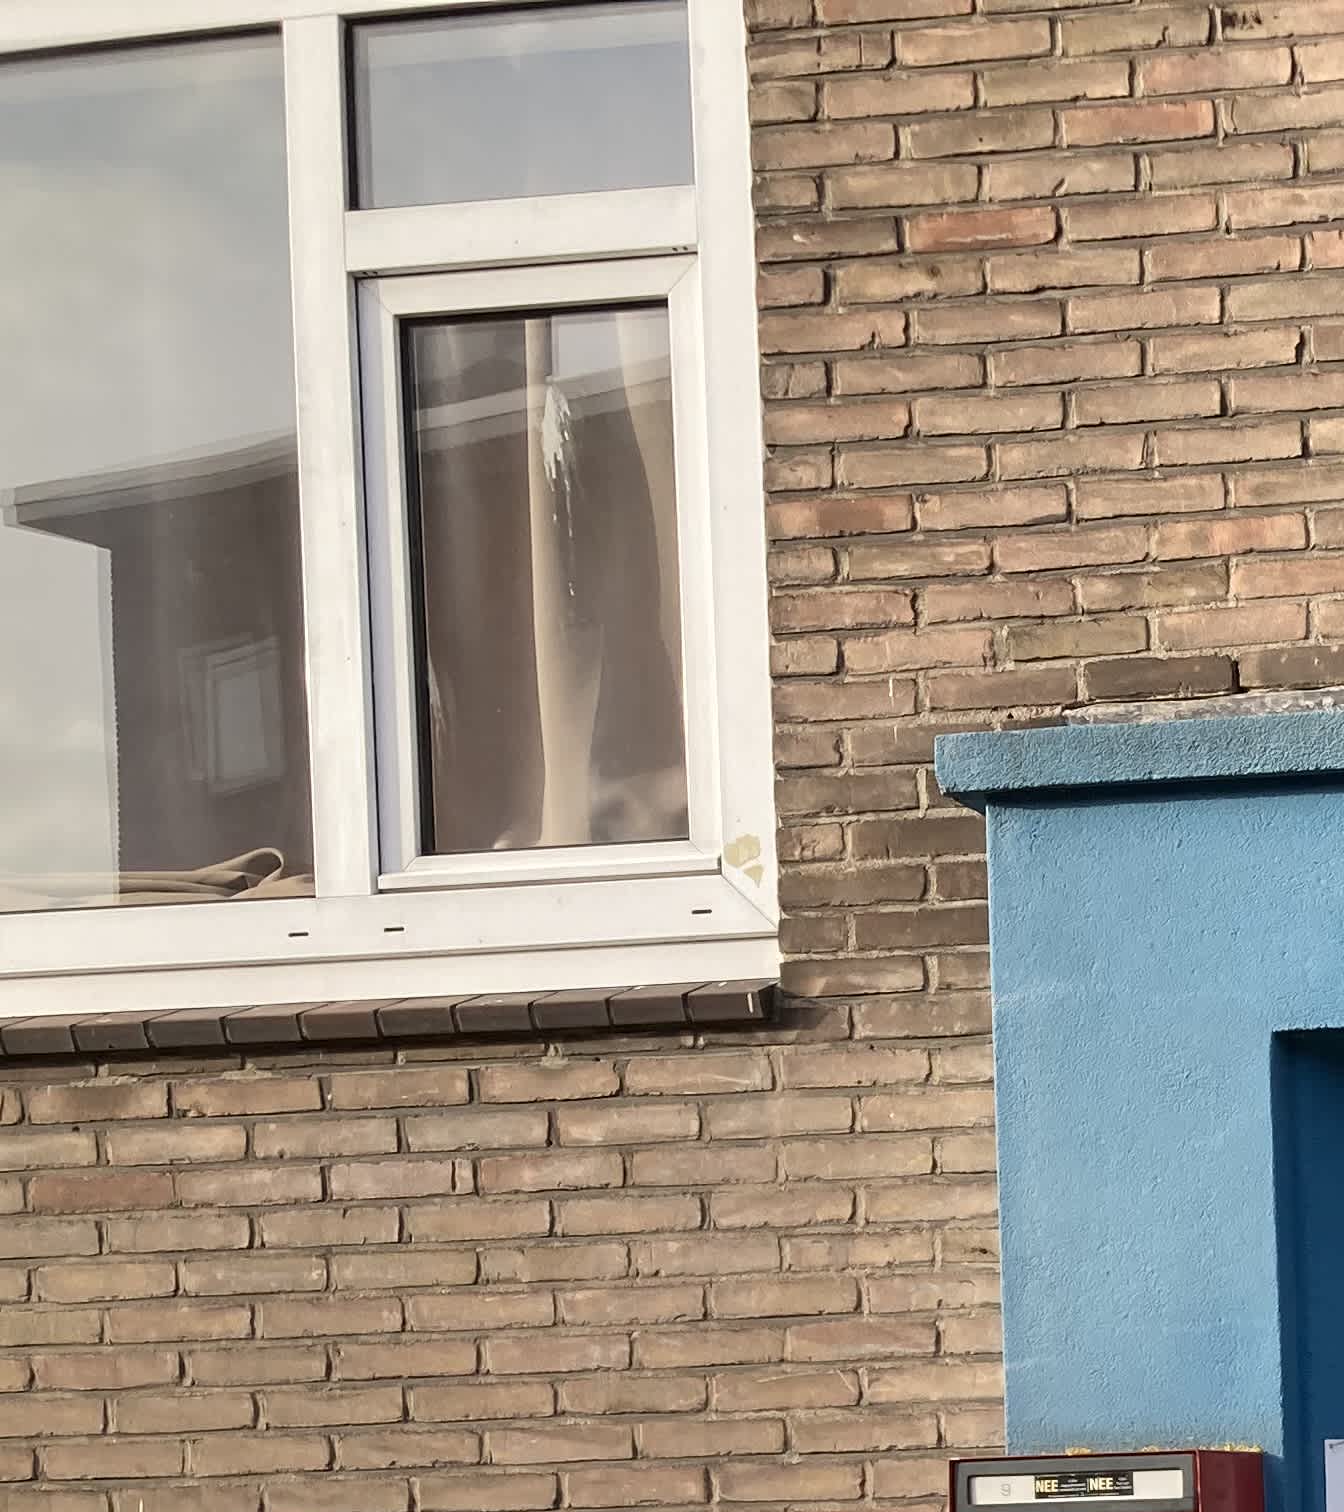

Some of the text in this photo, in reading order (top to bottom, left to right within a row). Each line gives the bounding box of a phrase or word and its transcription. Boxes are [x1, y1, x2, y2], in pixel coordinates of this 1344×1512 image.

[1000, 1482, 1012, 1497] 9
[1035, 1479, 1059, 1493] NEE
[1089, 1477, 1114, 1491] NEE
